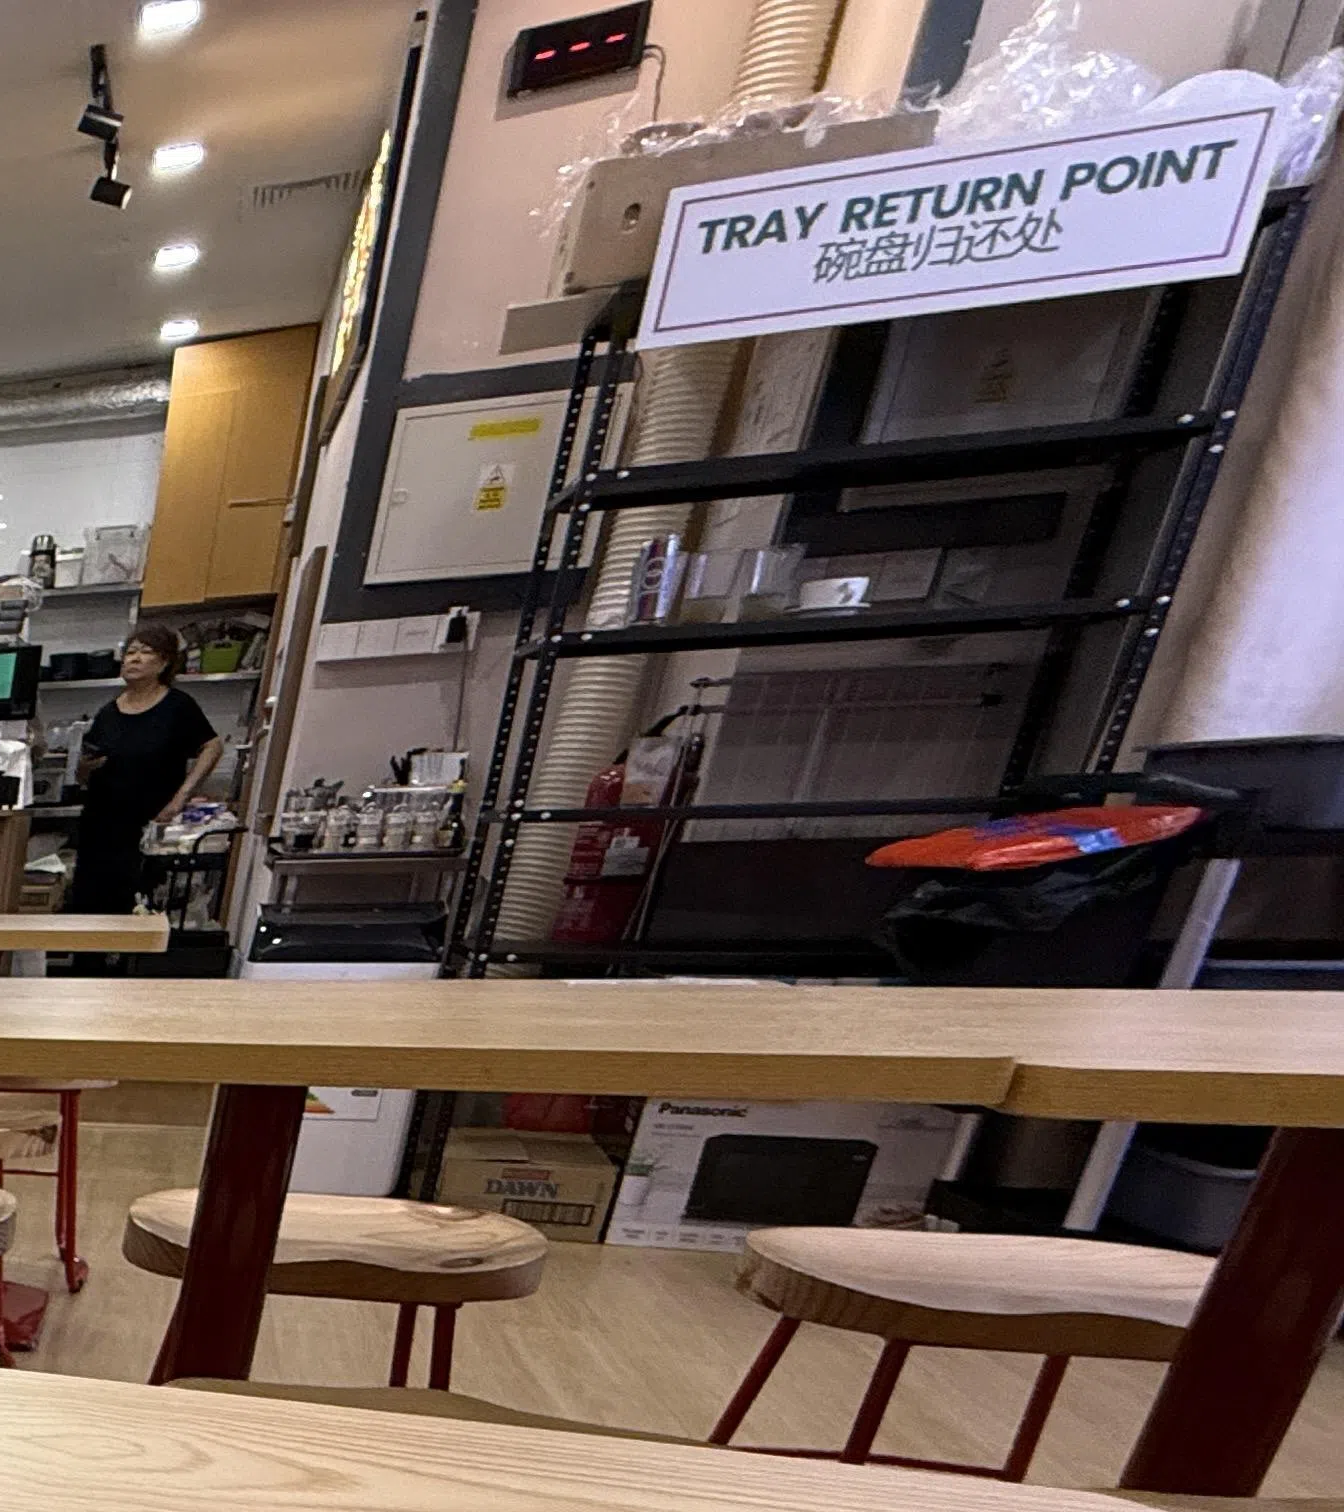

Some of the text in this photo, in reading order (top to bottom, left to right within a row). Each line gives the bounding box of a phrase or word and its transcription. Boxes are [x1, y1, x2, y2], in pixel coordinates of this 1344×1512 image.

[697, 137, 1238, 256] TRAY RETURN POINT
[812, 206, 1065, 285] 碗盘归还处
[658, 1101, 748, 1118] Panasonic
[485, 1178, 559, 1199] DAWN
